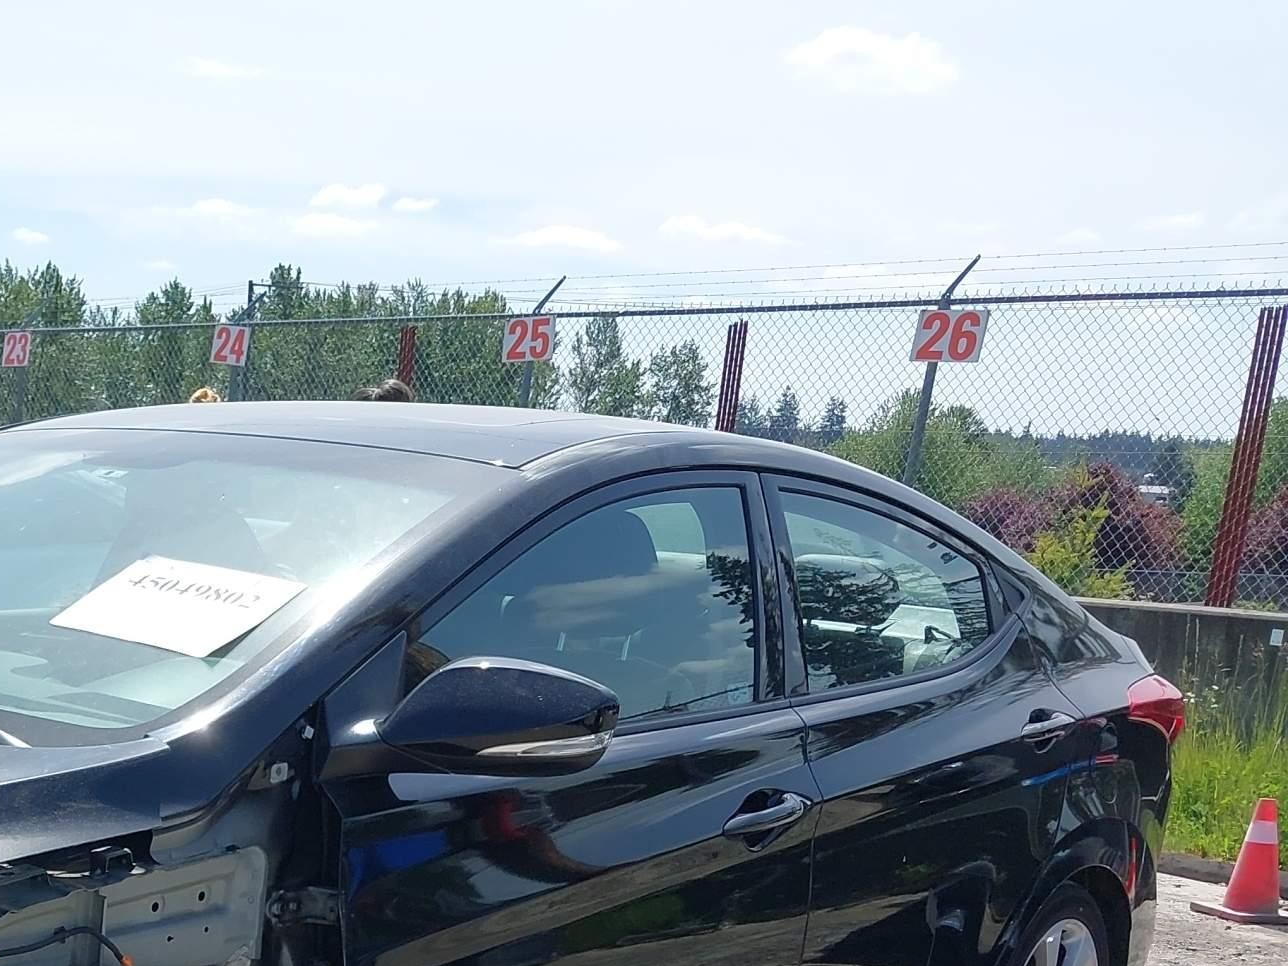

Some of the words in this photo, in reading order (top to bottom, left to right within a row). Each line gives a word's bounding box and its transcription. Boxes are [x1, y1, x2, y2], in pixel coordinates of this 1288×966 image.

[5, 334, 28, 364] 23
[214, 326, 245, 364] 24
[506, 318, 550, 360] 25
[915, 312, 981, 361] 26
[128, 574, 261, 608] 45049802
